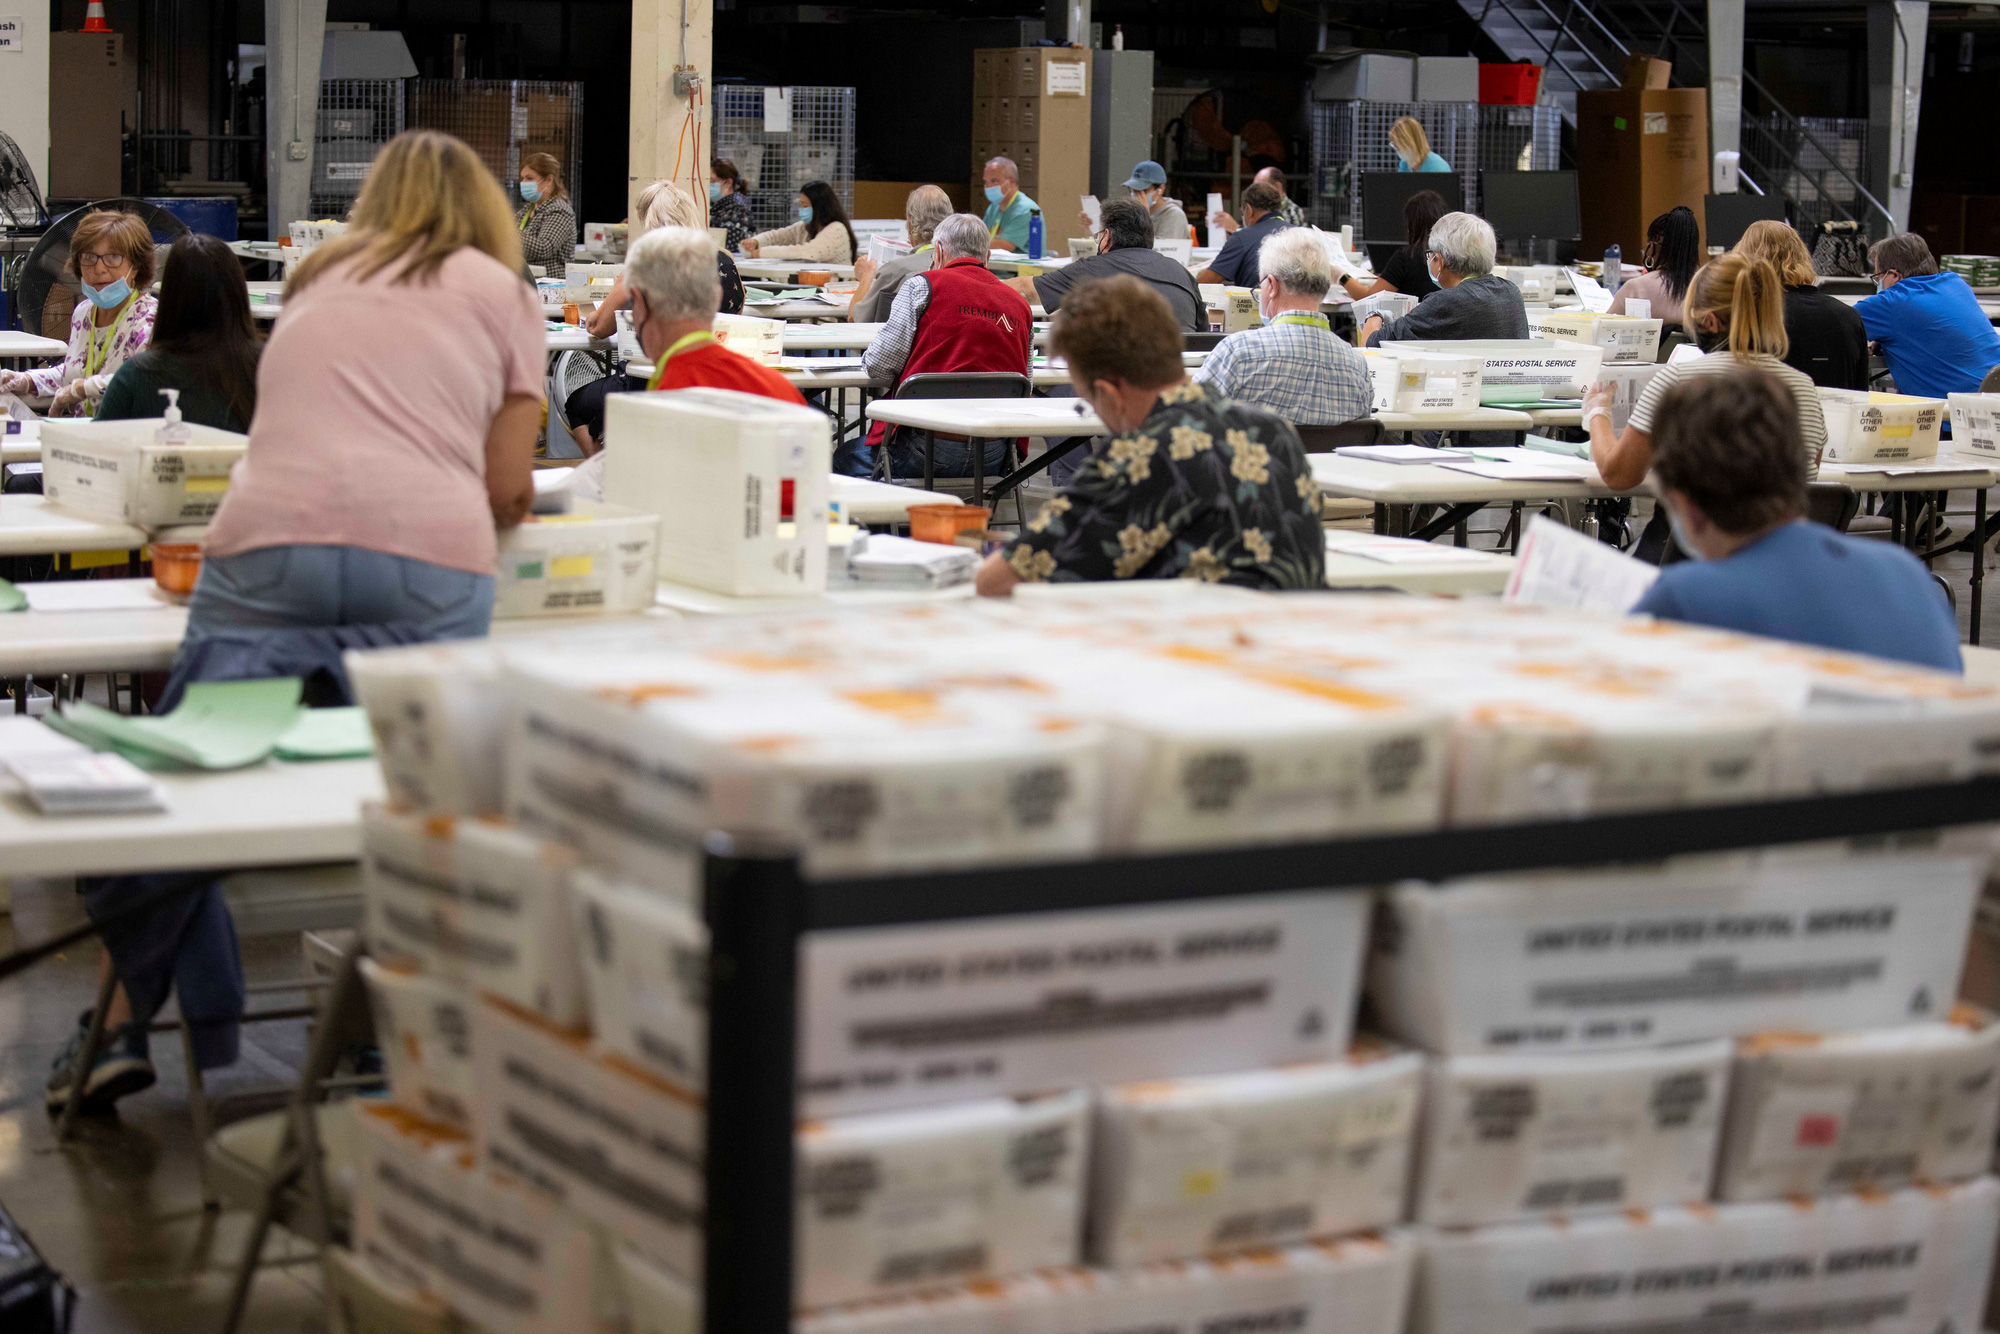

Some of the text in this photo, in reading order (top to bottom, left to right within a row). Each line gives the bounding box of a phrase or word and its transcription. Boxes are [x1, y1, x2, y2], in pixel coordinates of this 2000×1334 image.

[1537, 325, 1556, 334] POSTAL
[1556, 328, 1578, 336] SERVICE
[1485, 360, 1514, 368] STATES
[1514, 360, 1544, 368] POSTAL
[1916, 416, 1936, 424] OTHER
[154, 455, 183, 464] LABEL
[152, 463, 185, 473] OTHER
[158, 473, 179, 484] END
